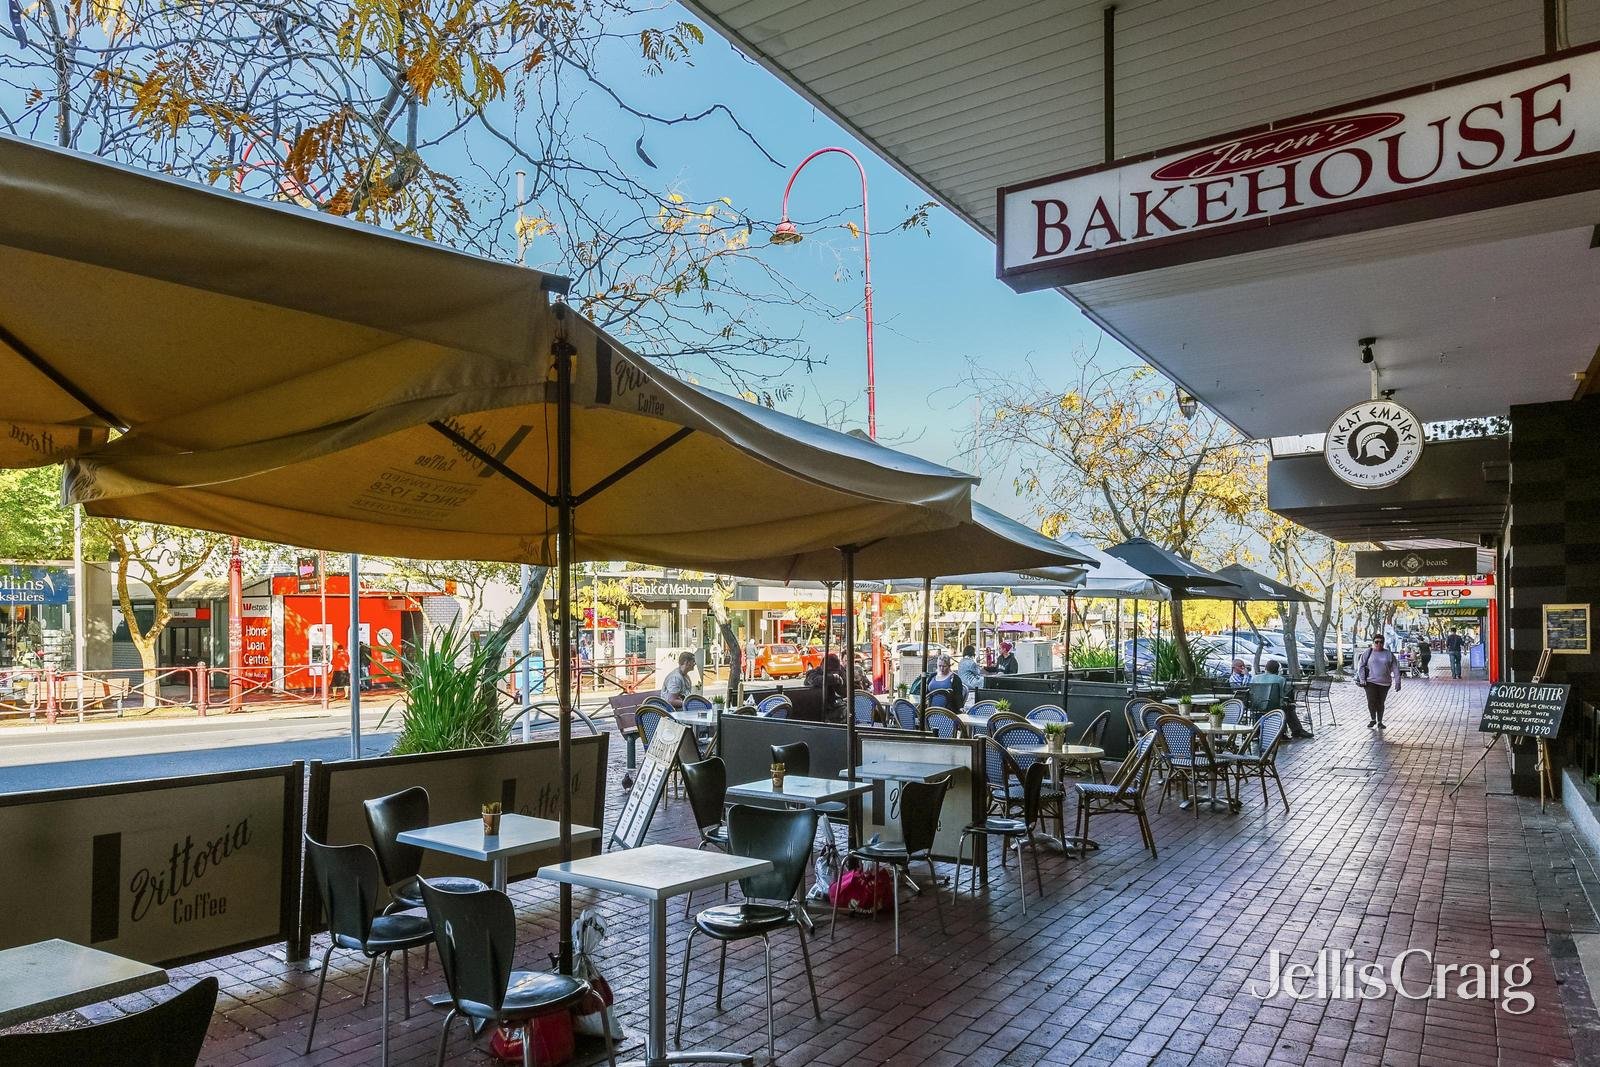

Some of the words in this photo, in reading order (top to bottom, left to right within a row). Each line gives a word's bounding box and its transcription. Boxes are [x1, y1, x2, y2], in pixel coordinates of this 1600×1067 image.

[1188, 123, 1359, 178] Jason's
[1030, 73, 1576, 260] BAKEHOUSE
[638, 392, 665, 416] Coffee
[1332, 410, 1362, 446] MEAT
[1369, 407, 1417, 442] EMPIRE
[1333, 453, 1369, 480] SOUVLAKI
[1379, 449, 1413, 478] BURGERS
[632, 583, 658, 595] Bank
[658, 583, 669, 595] of
[1402, 587, 1472, 598] redcargo
[243, 603, 269, 612] Westpac
[1434, 608, 1478, 616] SUBWAY
[245, 625, 268, 637] Home
[246, 640, 265, 650] Loan
[243, 653, 269, 665] Centre
[1498, 685, 1527, 699] GYROS
[1528, 687, 1564, 701] PLATTER
[130, 818, 252, 922] Vittoria
[173, 892, 227, 925] Coffee
